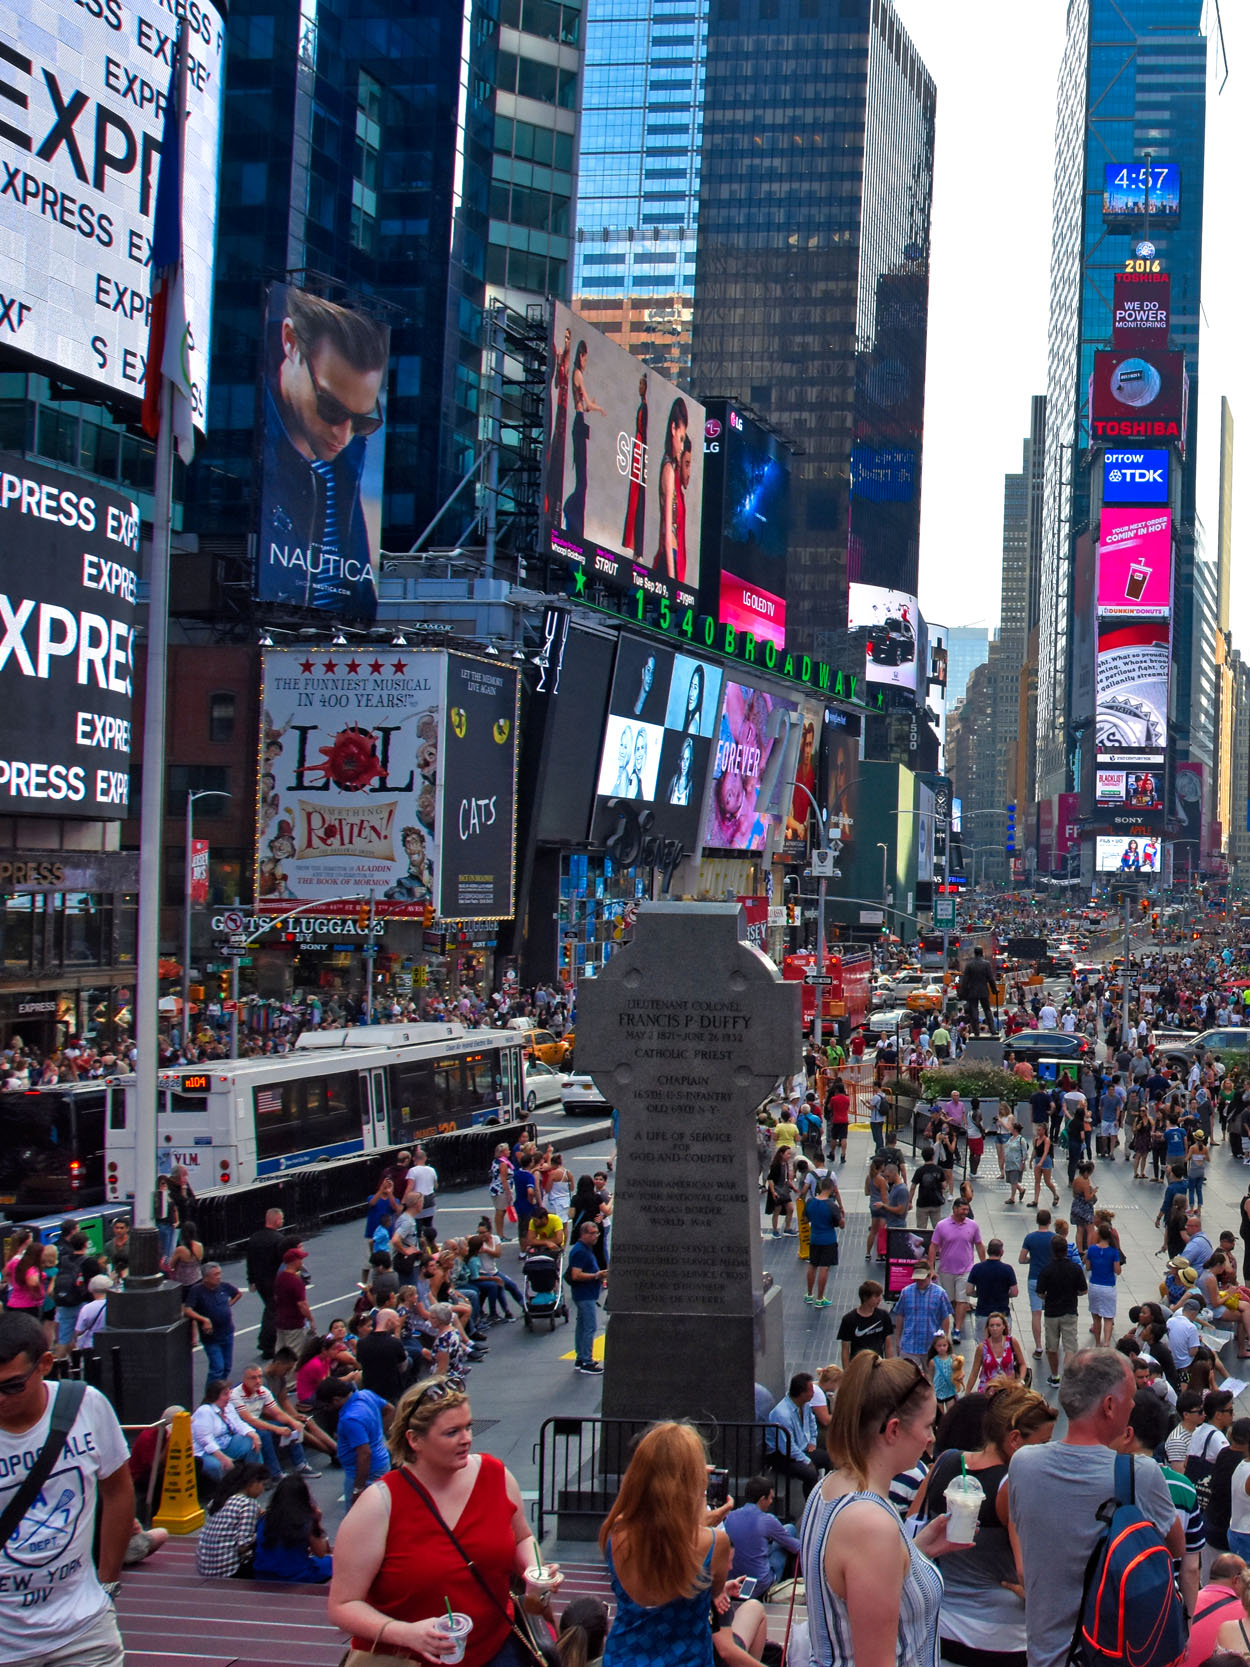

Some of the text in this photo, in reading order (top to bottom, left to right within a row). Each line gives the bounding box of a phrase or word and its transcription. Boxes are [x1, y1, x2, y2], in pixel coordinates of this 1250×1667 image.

[1114, 168, 1169, 189] 4:57
[1124, 260, 1161, 272] 2016
[1115, 273, 1169, 283] TOSHIBA
[1124, 301, 1159, 311] WE DO
[1116, 310, 1167, 321] POWER
[735, 417, 743, 431] LG
[1094, 421, 1178, 436] TOSHIBA
[703, 441, 720, 453] LG
[1121, 469, 1164, 482] TDK
[0, 471, 96, 532] PRESS
[1112, 516, 1168, 535] YOUR NEXT ORDER
[1137, 527, 1147, 536] IN
[1148, 522, 1167, 534] HOT
[551, 542, 586, 565] Whoopi Goldberg
[269, 543, 376, 584] NAUTICA
[595, 556, 619, 577] STRUT
[312, 582, 352, 596] NAUTICA.COM
[632, 572, 643, 587] Tue
[644, 577, 655, 593] Sep
[743, 590, 775, 617] LG OLED TV
[723, 623, 859, 699] BROADWAY
[1111, 654, 1131, 662] What
[1122, 659, 1148, 667] Whose
[1104, 668, 1136, 681] perilous
[274, 678, 431, 691] THE FUNNIEST MUSICAL
[297, 693, 349, 708] IN 400
[909, 715, 918, 750] 1500
[715, 740, 761, 777] FOREVER
[1098, 774, 1124, 783] BLACKLIST
[458, 795, 497, 840] CATS
[1115, 816, 1143, 824] SONY
[1129, 827, 1152, 835] APPLE
[355, 865, 392, 873] ALADDIN
[316, 878, 338, 886] BOOK
[287, 918, 384, 936] LUGGAGE
[300, 943, 328, 951] SONY
[18, 1001, 57, 1014] EXPRESS
[619, 1013, 752, 1029] FRANCIS DUFFY
[634, 1049, 733, 1061] CATHOLIC PRIEST
[657, 1075, 710, 1086] CHAPLAIN
[646, 1132, 668, 1142] LIFE
[671, 1133, 686, 1142] OF
[689, 1132, 732, 1142] SERVICE
[47, 1557, 82, 1584] YORK
[22, 1586, 55, 1607] DIV
